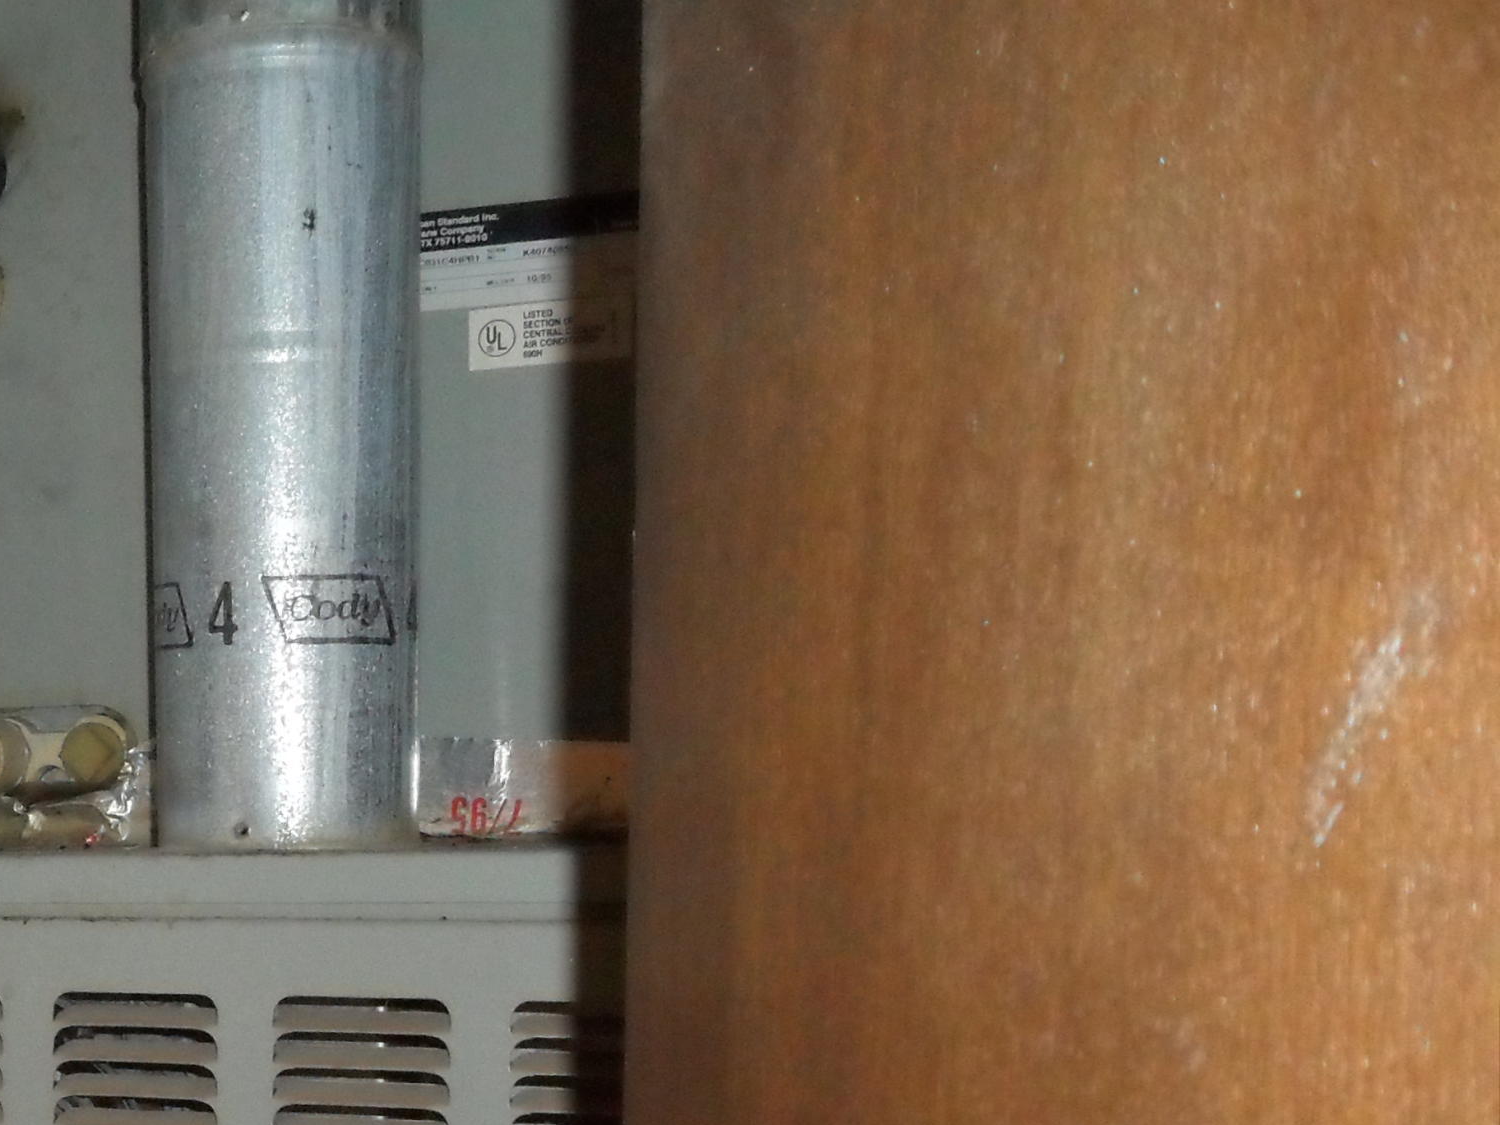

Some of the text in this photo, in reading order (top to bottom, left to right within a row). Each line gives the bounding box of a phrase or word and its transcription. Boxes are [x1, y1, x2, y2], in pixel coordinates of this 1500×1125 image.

[437, 213, 480, 226] Standard
[482, 212, 500, 221] Inc.
[440, 224, 484, 237] Company
[523, 309, 553, 320] LISTED
[523, 319, 561, 329] SECTION
[486, 326, 507, 351] UL
[523, 329, 562, 339] CENTRAL
[523, 340, 538, 349] AIR
[208, 581, 238, 645] 4
